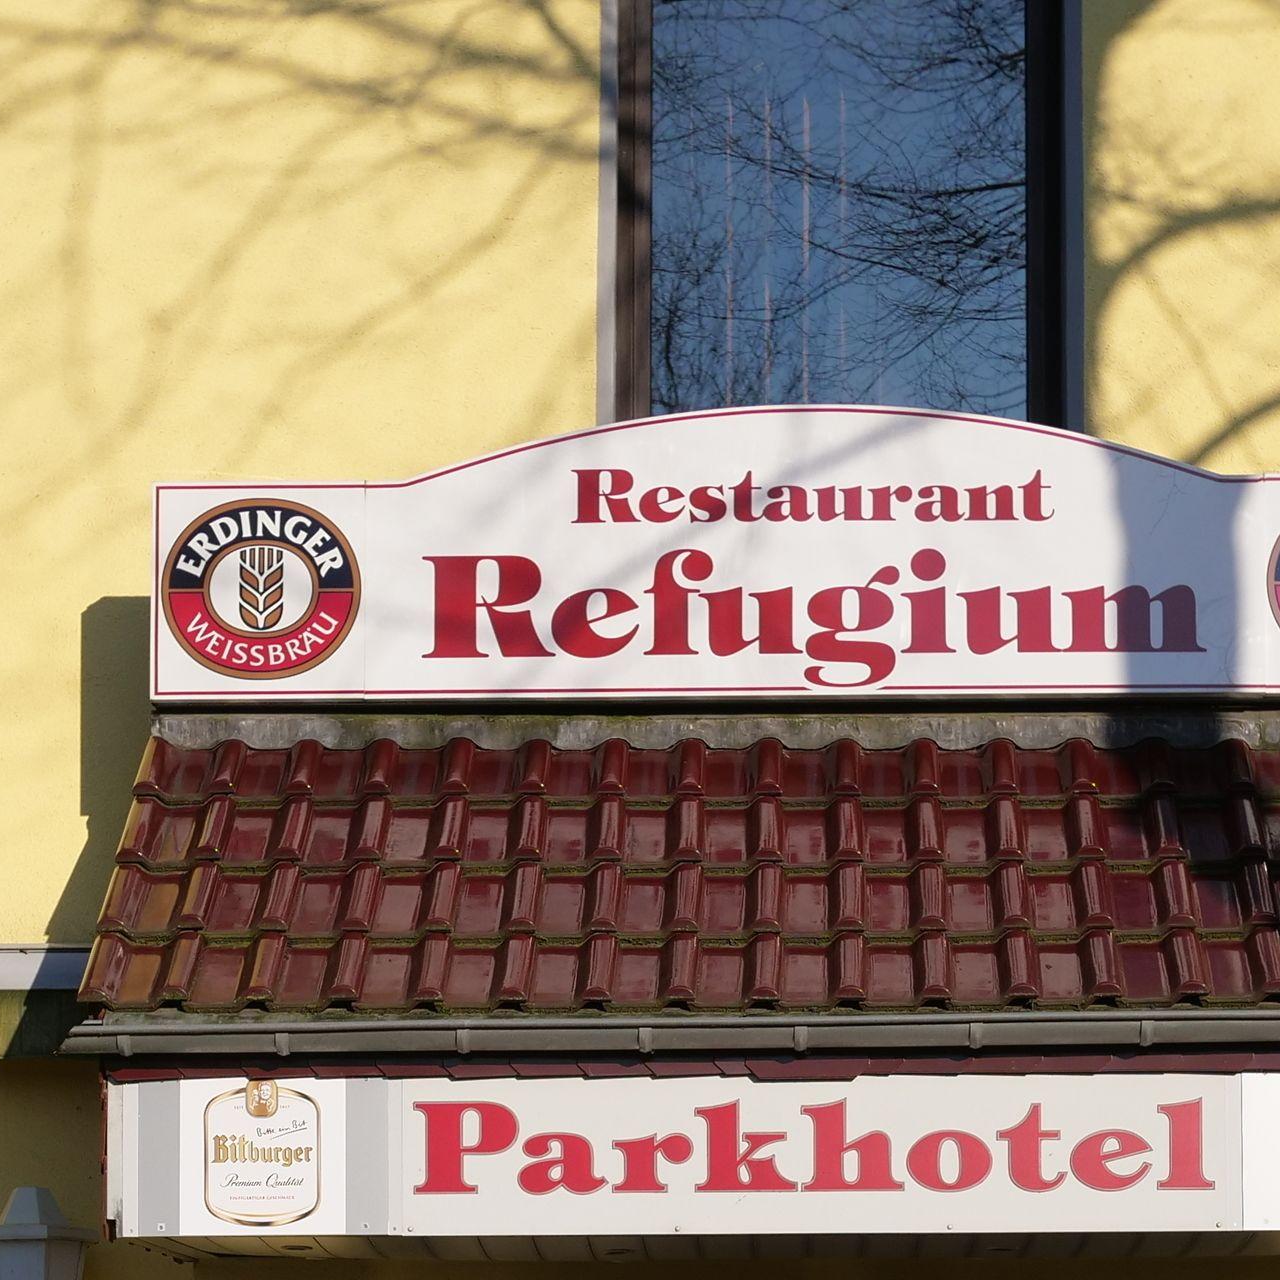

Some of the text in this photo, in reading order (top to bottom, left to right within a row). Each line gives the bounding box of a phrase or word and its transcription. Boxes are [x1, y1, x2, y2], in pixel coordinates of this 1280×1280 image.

[571, 467, 1054, 524] Restaurant
[176, 510, 344, 578] ERDINGER
[186, 611, 340, 667] WEISSBRÄU
[420, 548, 1207, 690] Refugium
[210, 1134, 314, 1167] Bitburger
[412, 1097, 1220, 1195] Parkhotel
[220, 1172, 305, 1189] Premium Qualität
